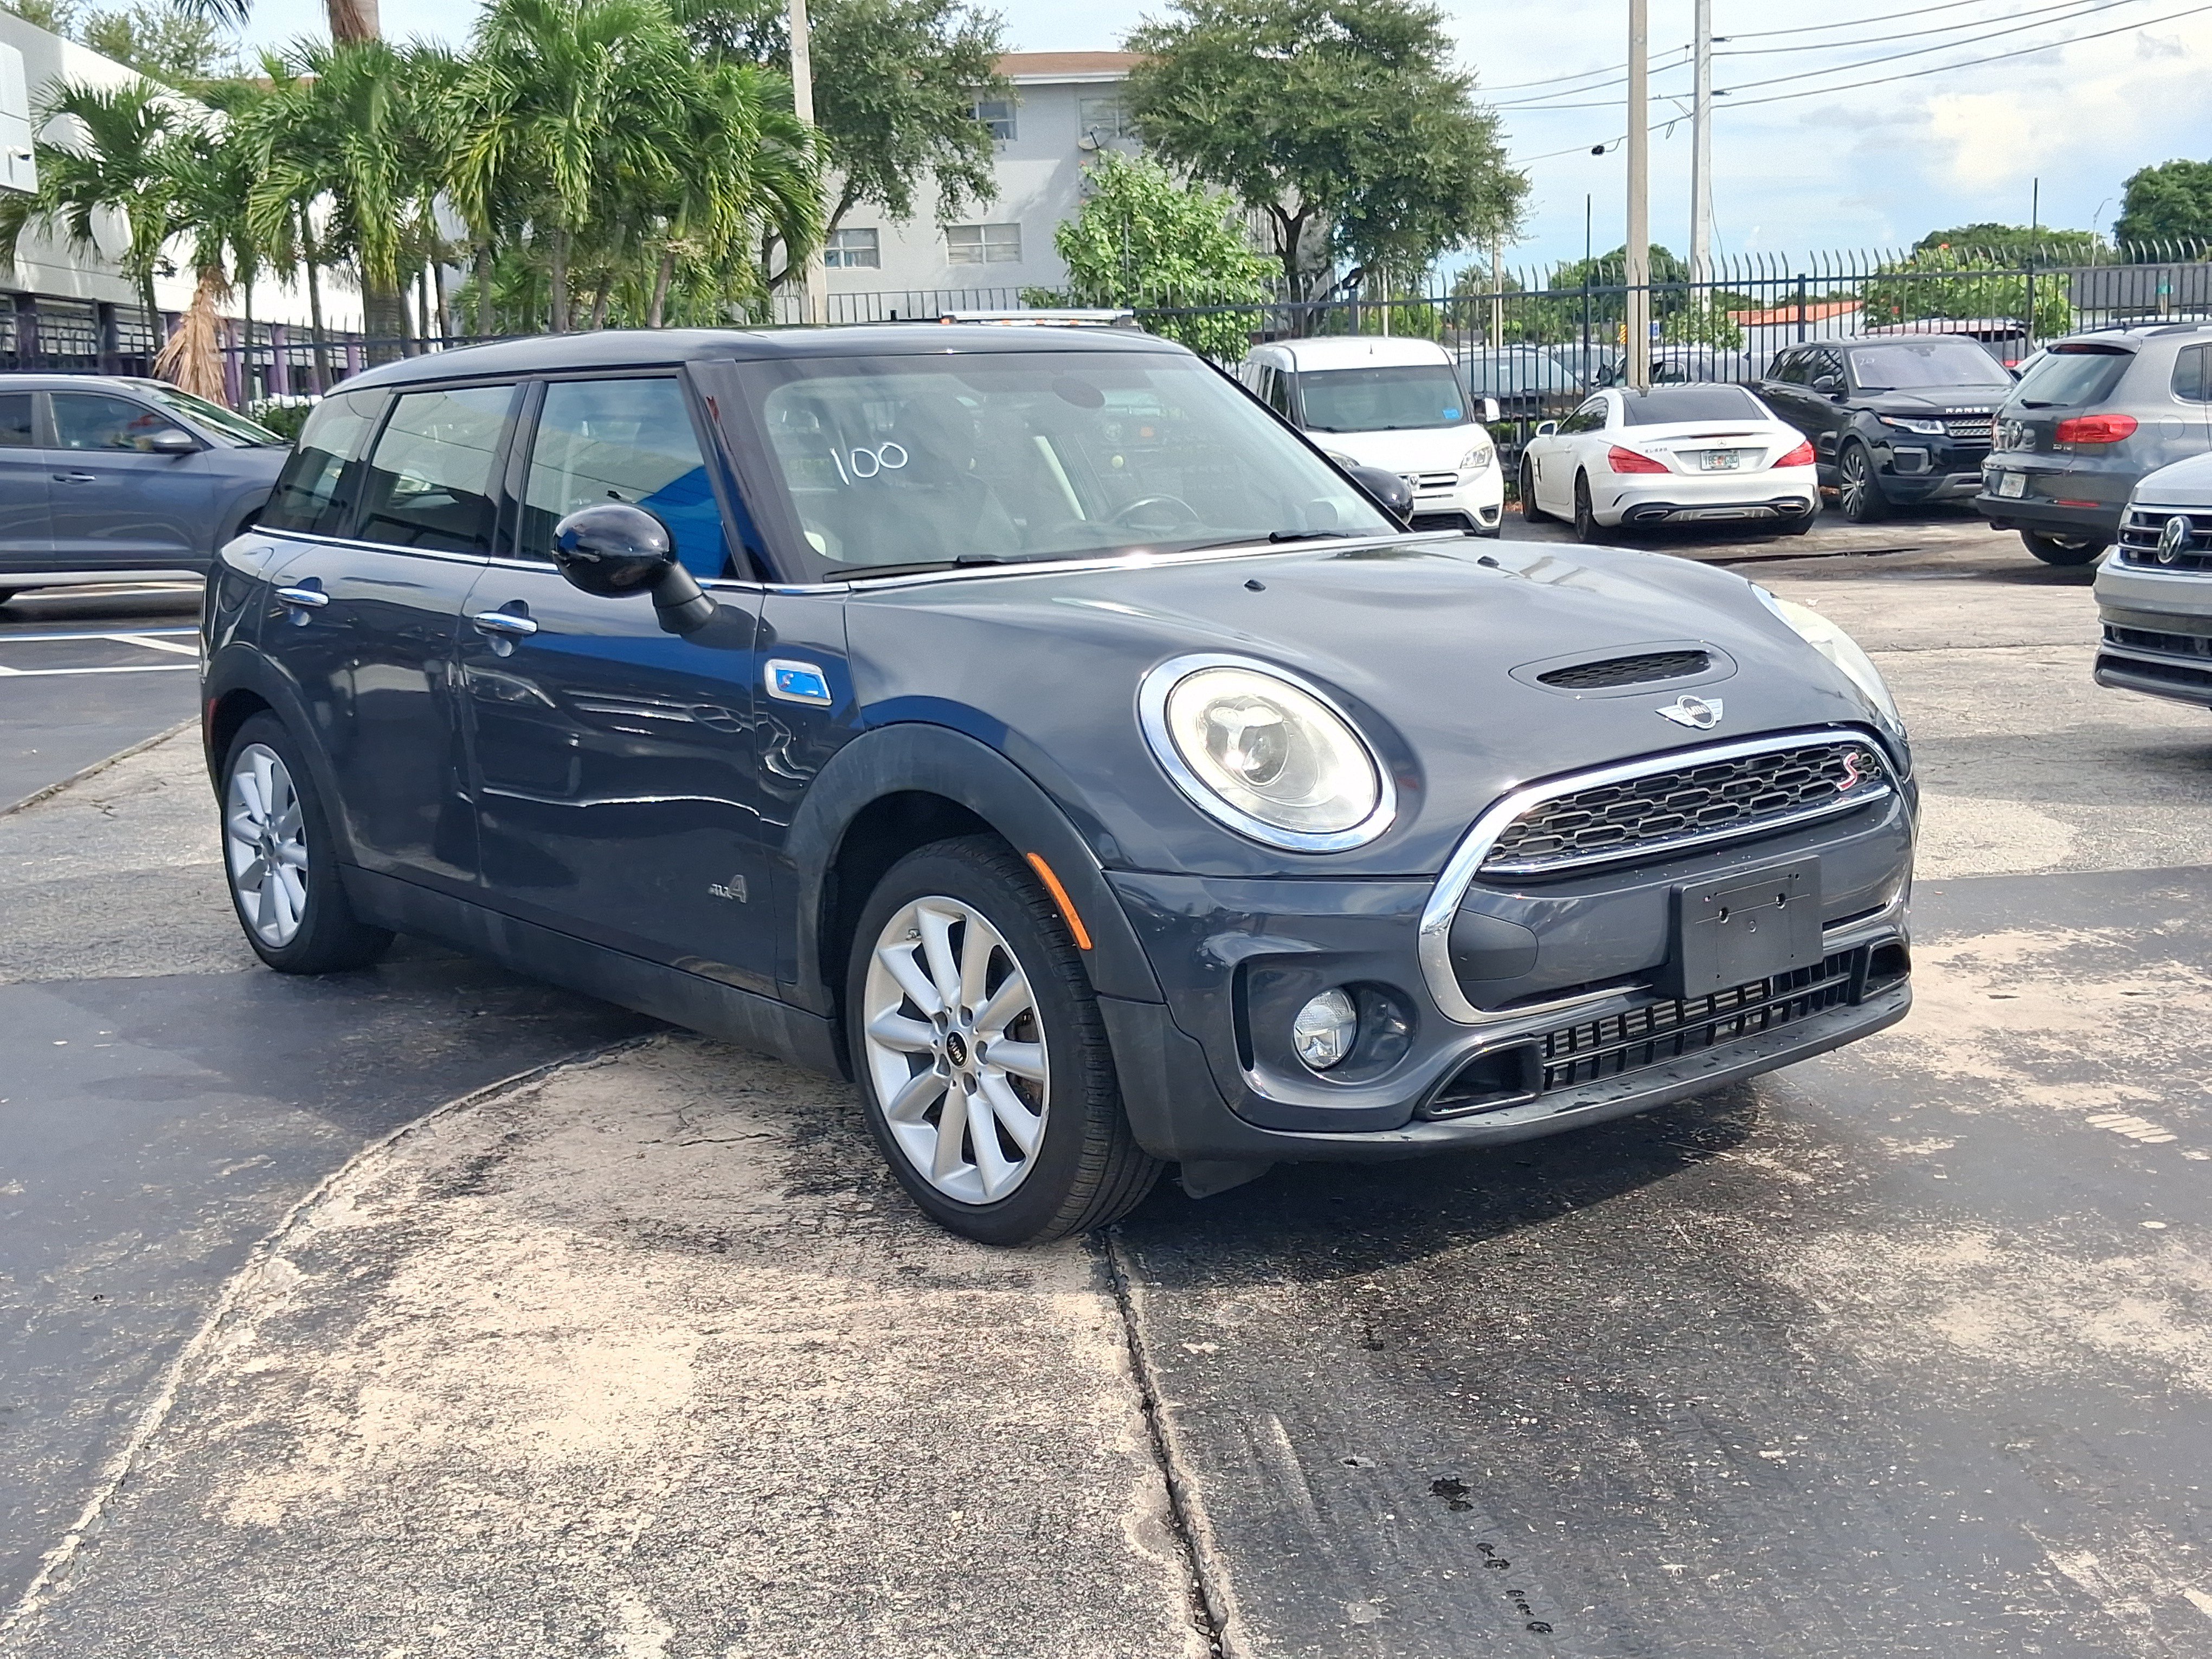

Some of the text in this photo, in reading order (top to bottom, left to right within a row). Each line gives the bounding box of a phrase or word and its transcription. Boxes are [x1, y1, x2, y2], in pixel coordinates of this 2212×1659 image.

[829, 441, 909, 485] 100
[1685, 704, 1711, 717] MINI
[1836, 752, 1859, 792] S
[948, 1036, 964, 1063] MINI
